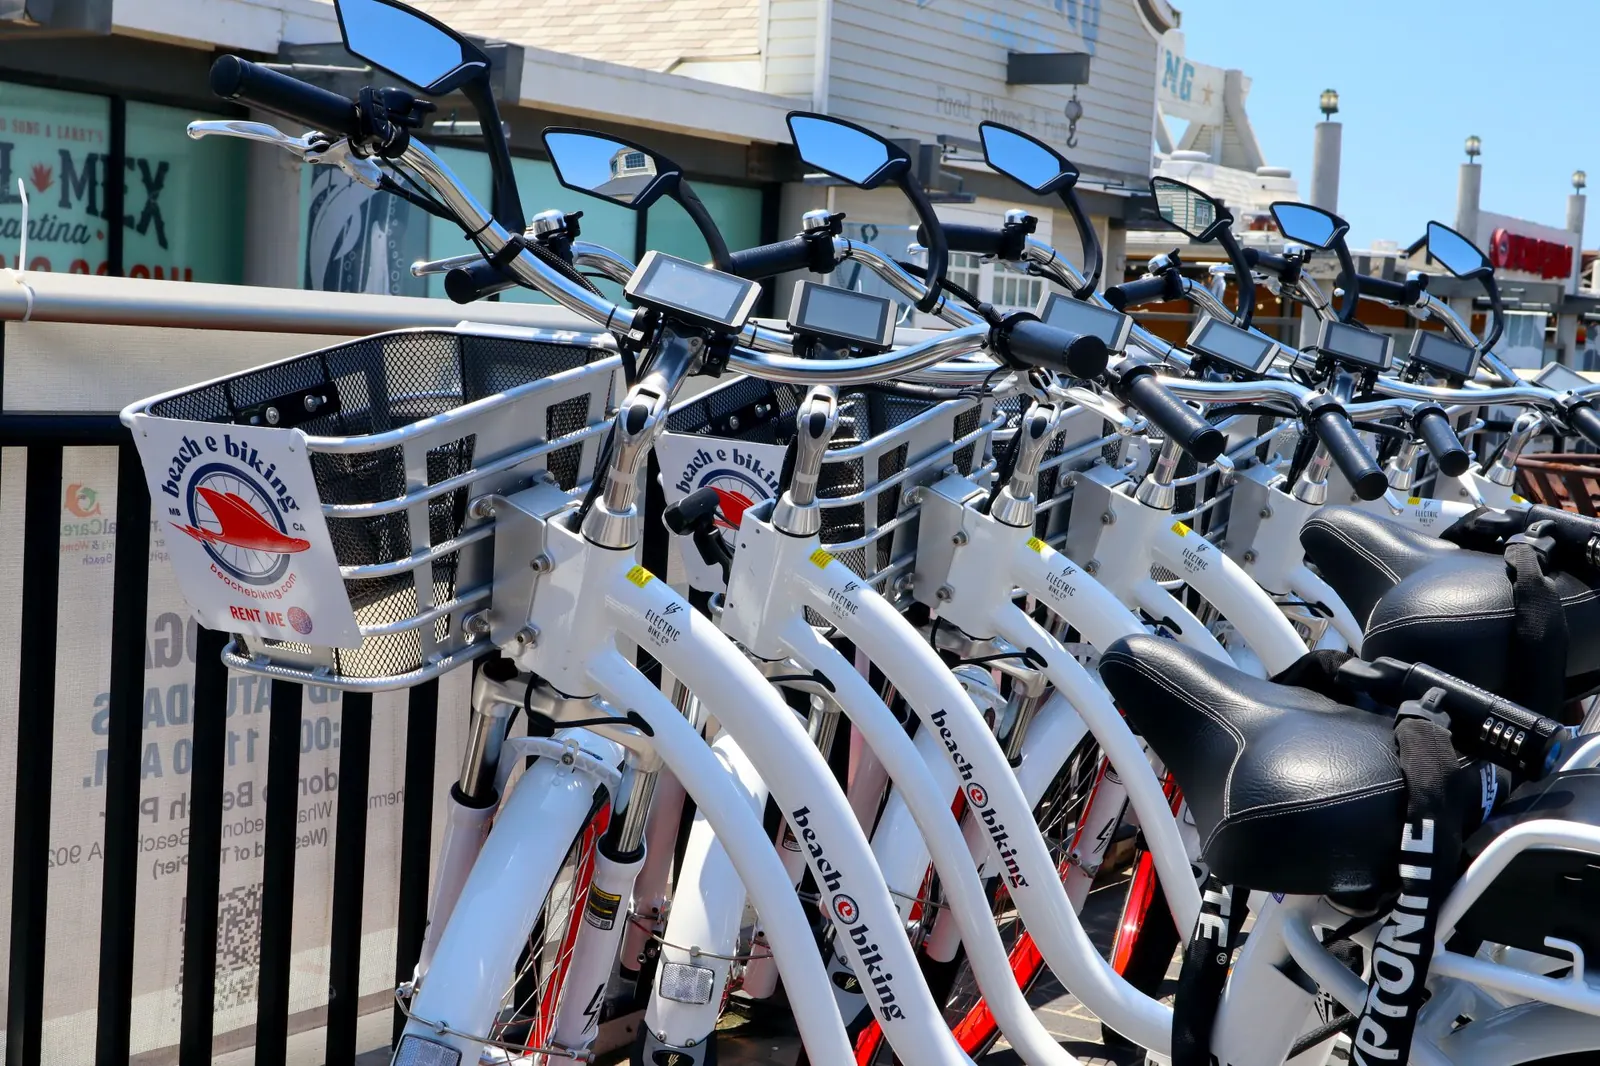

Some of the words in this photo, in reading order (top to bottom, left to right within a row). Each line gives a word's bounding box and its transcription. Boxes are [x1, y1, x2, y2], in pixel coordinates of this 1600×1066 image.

[161, 435, 204, 499] beach
[204, 435, 218, 452] e
[223, 434, 300, 514] biking
[675, 448, 714, 495] beach
[716, 448, 727, 462] e
[168, 507, 182, 517] MB
[292, 522, 306, 532] CA
[1182, 547, 1209, 571] ELECTRIC
[209, 562, 297, 600] beachebiking.com
[1045, 571, 1076, 597] ELECTRIC
[229, 605, 262, 623] RENT
[264, 611, 286, 628] ME
[828, 587, 859, 615] ELECTRIC
[645, 608, 681, 642] ELECTRIC
[647, 625, 661, 640] BIKE
[931, 708, 974, 782] beach
[981, 807, 1030, 889] biking
[792, 806, 843, 893] beach
[849, 924, 907, 1022] biking
